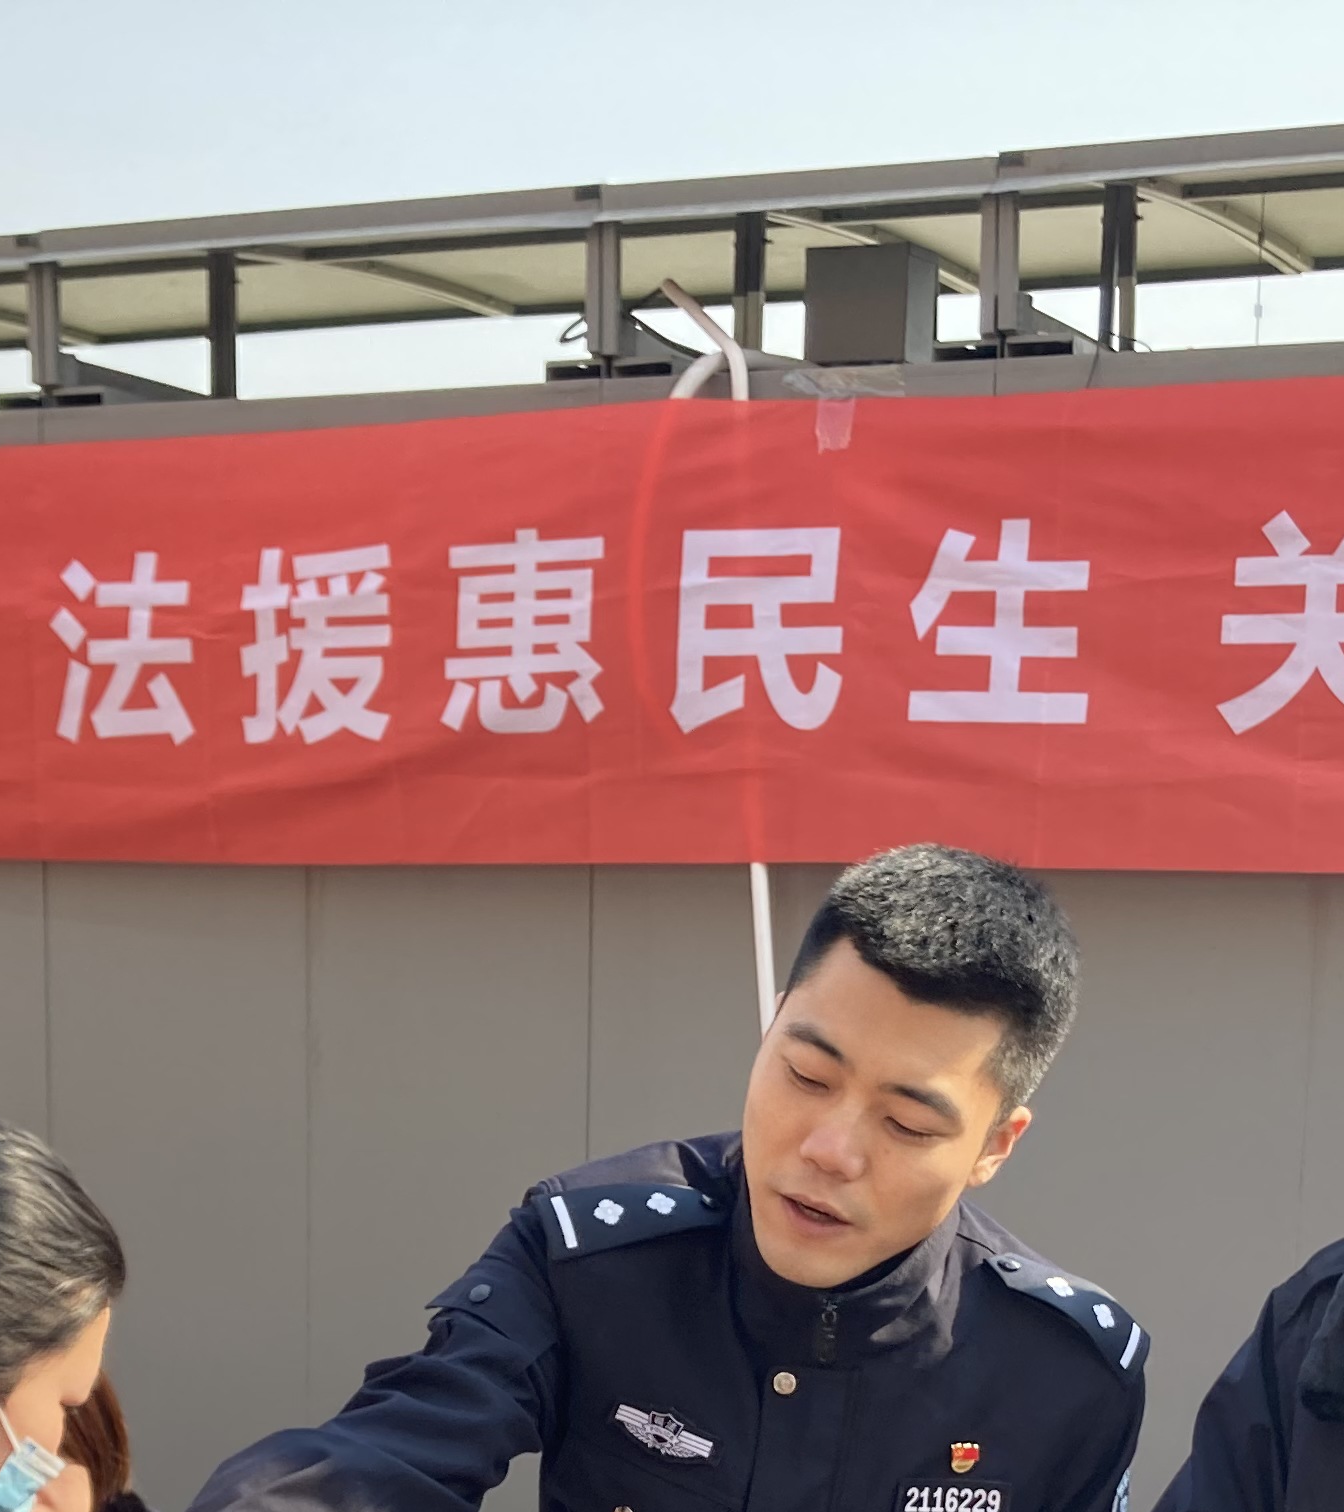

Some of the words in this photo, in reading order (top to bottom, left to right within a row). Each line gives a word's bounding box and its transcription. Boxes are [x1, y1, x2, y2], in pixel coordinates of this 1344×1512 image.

[50, 517, 1092, 744] 法援惠民生
